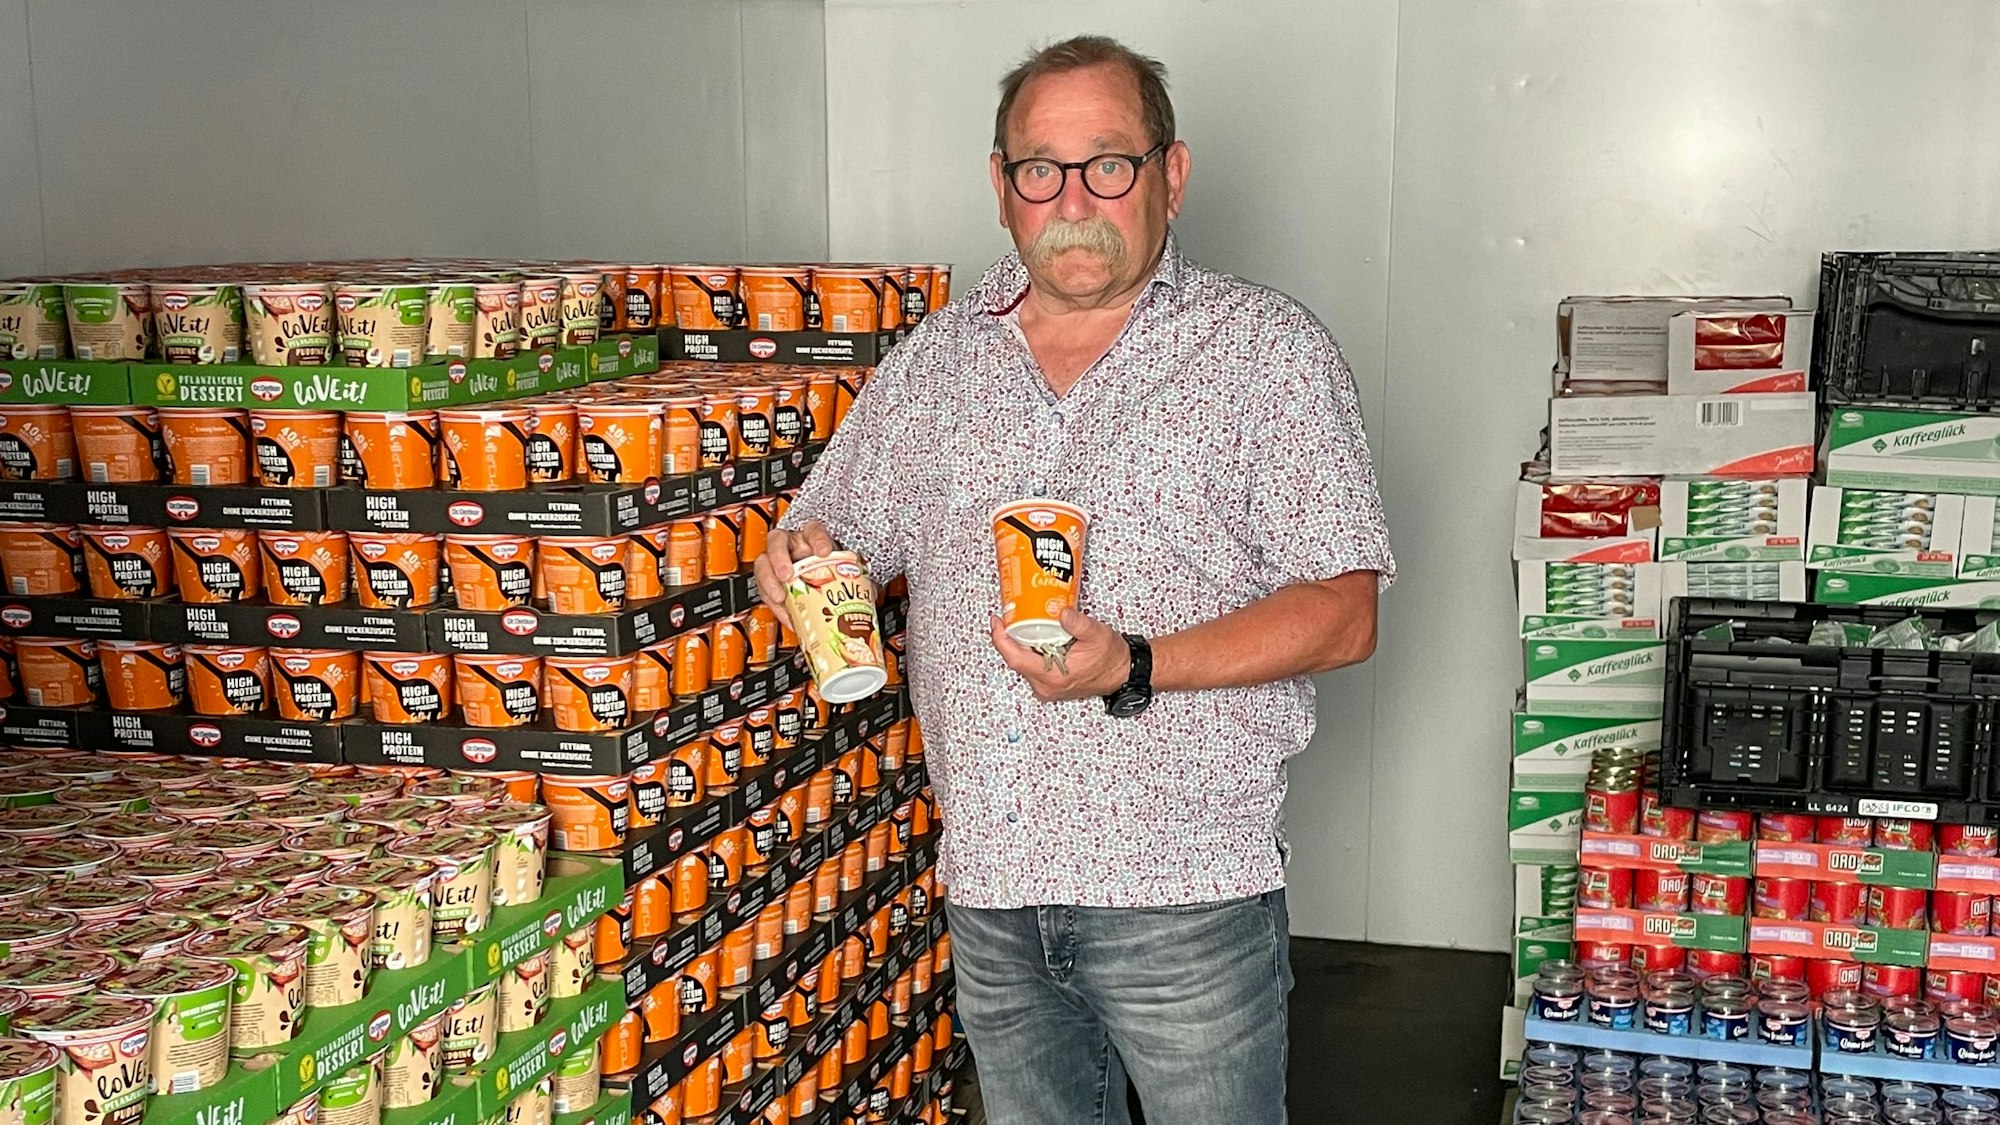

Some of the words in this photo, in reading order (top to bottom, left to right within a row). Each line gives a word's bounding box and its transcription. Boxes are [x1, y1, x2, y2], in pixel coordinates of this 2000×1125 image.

[685, 334, 709, 345] HIGH
[685, 344, 718, 353] PROTEIN
[180, 386, 243, 402] DESSERT
[777, 412, 796, 421] HIGH
[743, 419, 764, 430] HIGH
[743, 429, 769, 437] PROTEIN
[1893, 423, 1967, 448] Kaffeeglück
[87, 491, 116, 503] HIGH
[366, 497, 397, 509] HIGH
[89, 504, 128, 514] PROTEIN
[367, 510, 409, 521] PROTEIN
[1036, 538, 1063, 551] HIGH
[1036, 550, 1071, 563] PROTEIN
[114, 560, 141, 571] HIGH
[203, 563, 230, 573] HIGH
[115, 570, 151, 580] PROTEIN
[203, 572, 240, 583] PROTEIN
[283, 567, 309, 578] HIGH
[371, 570, 397, 580] HIGH
[501, 569, 525, 580] HIGH
[600, 570, 622, 583] HIGH
[284, 577, 320, 587] PROTEIN
[372, 580, 408, 589] PROTEIN
[501, 579, 530, 590] PROTEIN
[187, 609, 216, 620] HIGH
[188, 621, 228, 632] PROTEIN
[444, 618, 475, 631] HIGH
[445, 632, 487, 642] PROTEIN
[1587, 652, 1653, 677] Kaffeeglück
[227, 677, 253, 688] HIGH
[294, 683, 321, 694] HIGH
[228, 685, 261, 697] PROTEIN
[295, 692, 331, 702] PROTEIN
[402, 685, 429, 698] HIGH
[506, 687, 530, 700] HIGH
[403, 694, 438, 706] PROTEIN
[506, 697, 536, 709] PROTEIN
[592, 691, 618, 704] HIGH
[593, 700, 625, 713] PROTEIN
[113, 716, 141, 728] HIGH
[779, 713, 797, 725] HIGH
[114, 729, 152, 739] PROTEIN
[382, 732, 412, 745] HIGH
[1573, 728, 1638, 750] Kaffeeglück
[383, 745, 424, 755] PROTEIN
[639, 787, 661, 801] HIGH
[1808, 803, 1820, 811] LL
[1826, 804, 1848, 812] 6424
[1893, 804, 1920, 812] IFCO
[1653, 844, 1677, 859] ORO
[1832, 853, 1857, 869] ORO
[1661, 879, 1680, 891] ORO
[1646, 918, 1670, 933] ORO
[1826, 931, 1850, 947] ORO
[502, 931, 541, 967] DESSERT
[1841, 970, 1859, 982] ORO
[317, 1036, 365, 1080] DESSERT
[509, 1050, 546, 1090] DESSERT
